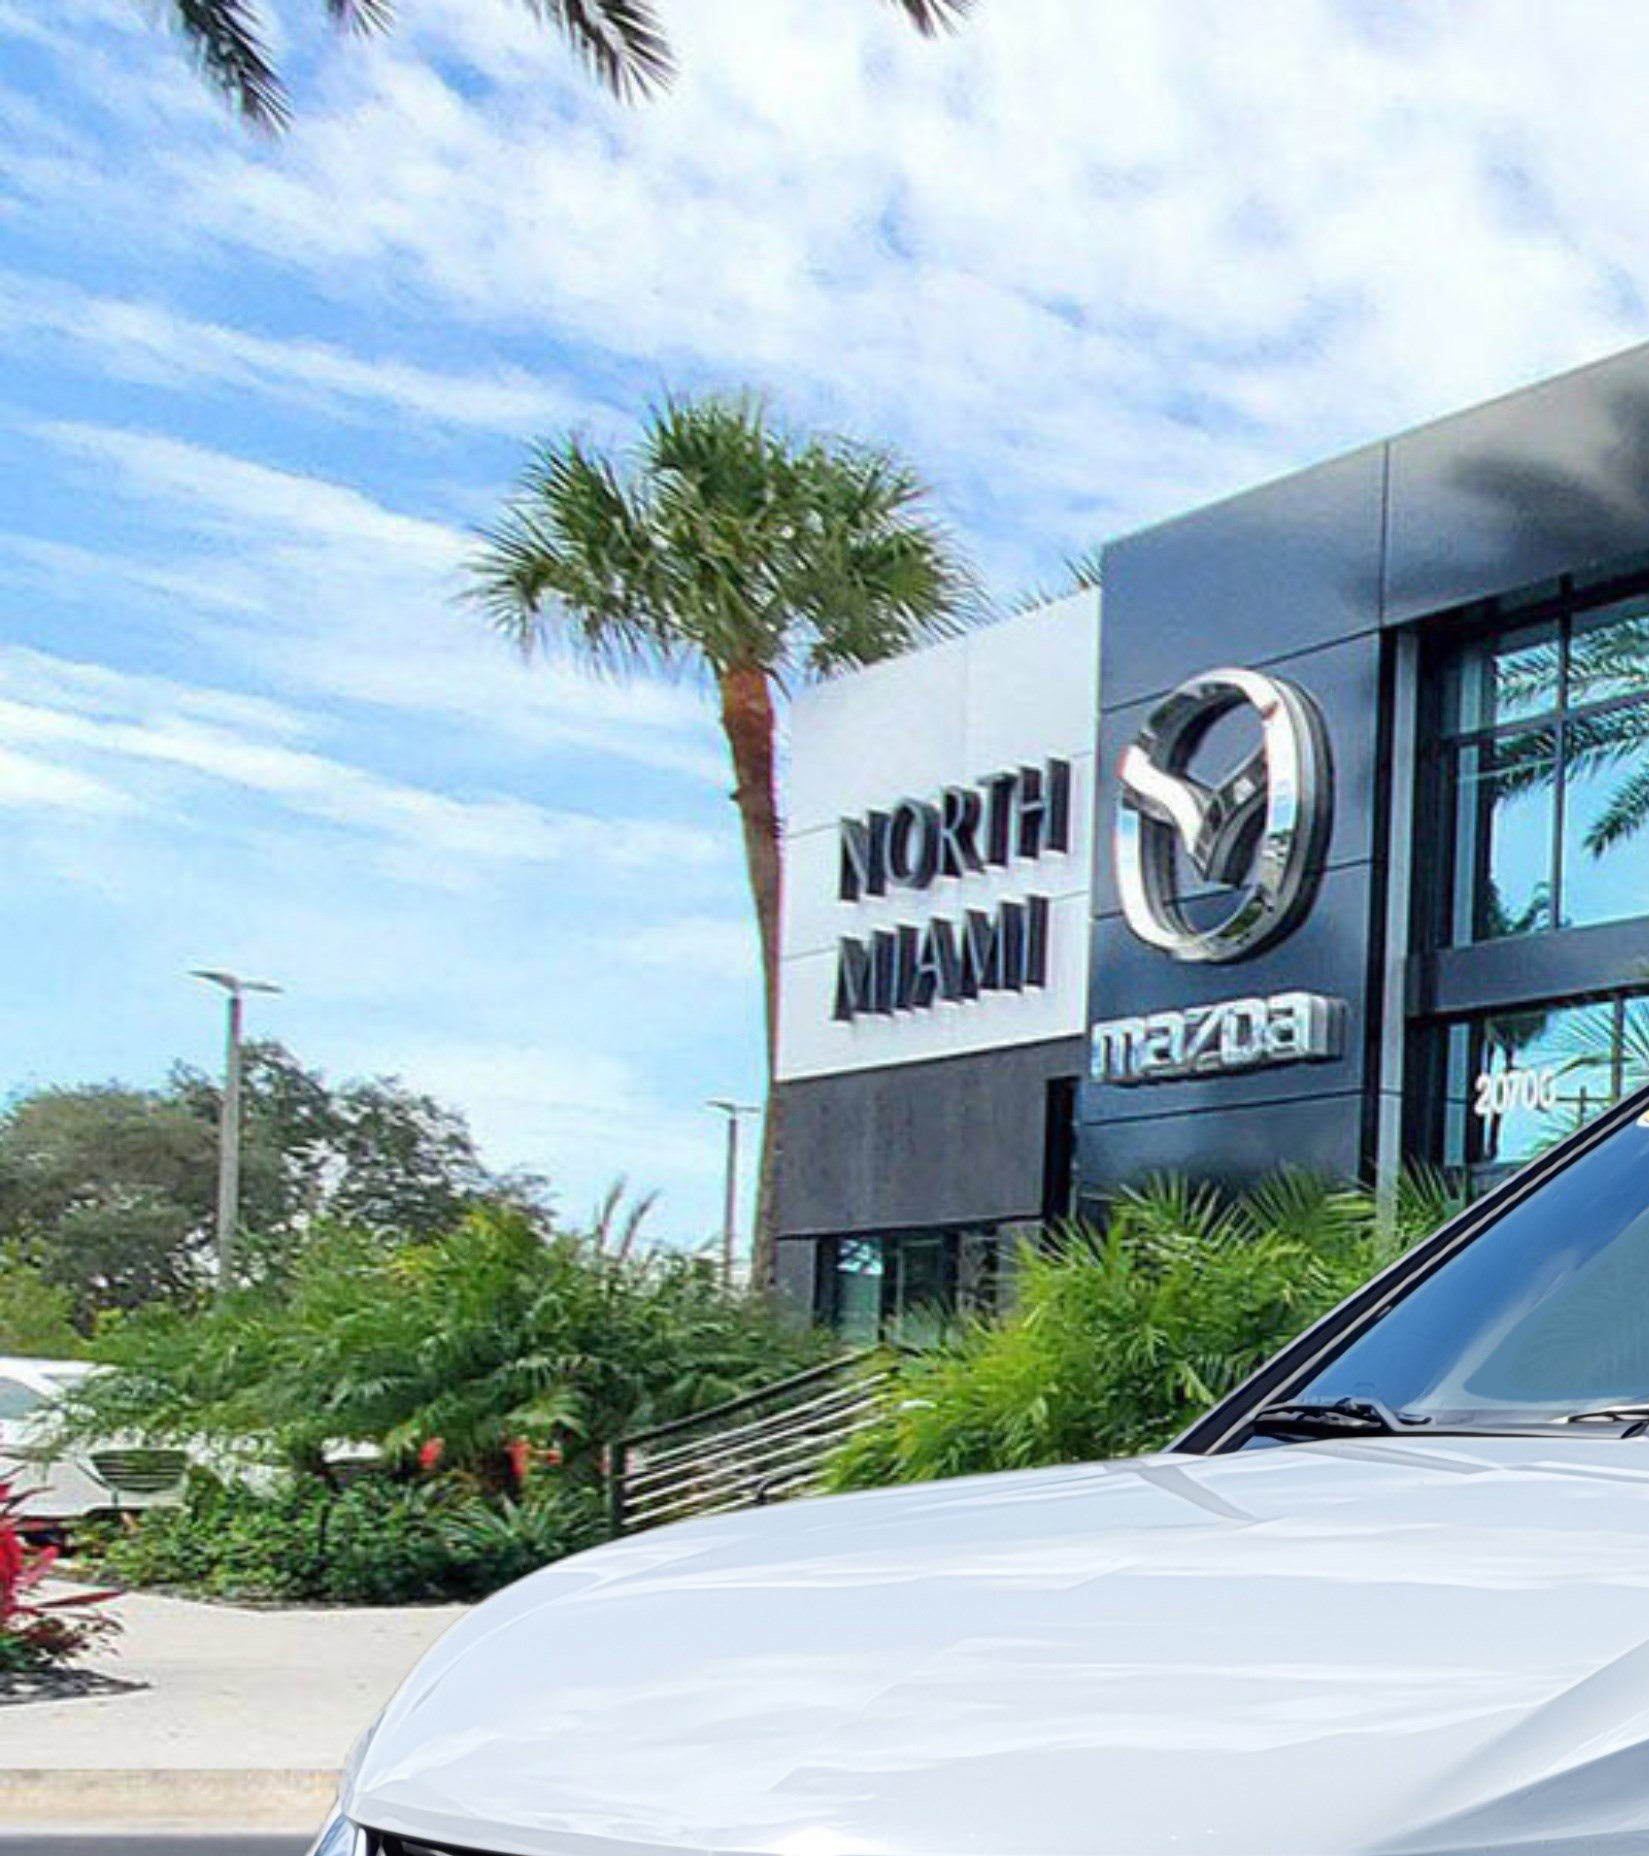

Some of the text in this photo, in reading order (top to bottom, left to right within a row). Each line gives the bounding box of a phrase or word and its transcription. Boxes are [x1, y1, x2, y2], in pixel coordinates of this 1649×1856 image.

[839, 757, 1070, 901] NORTH
[834, 896, 1049, 1021] MIAMI
[1089, 993, 1342, 1085] mazda
